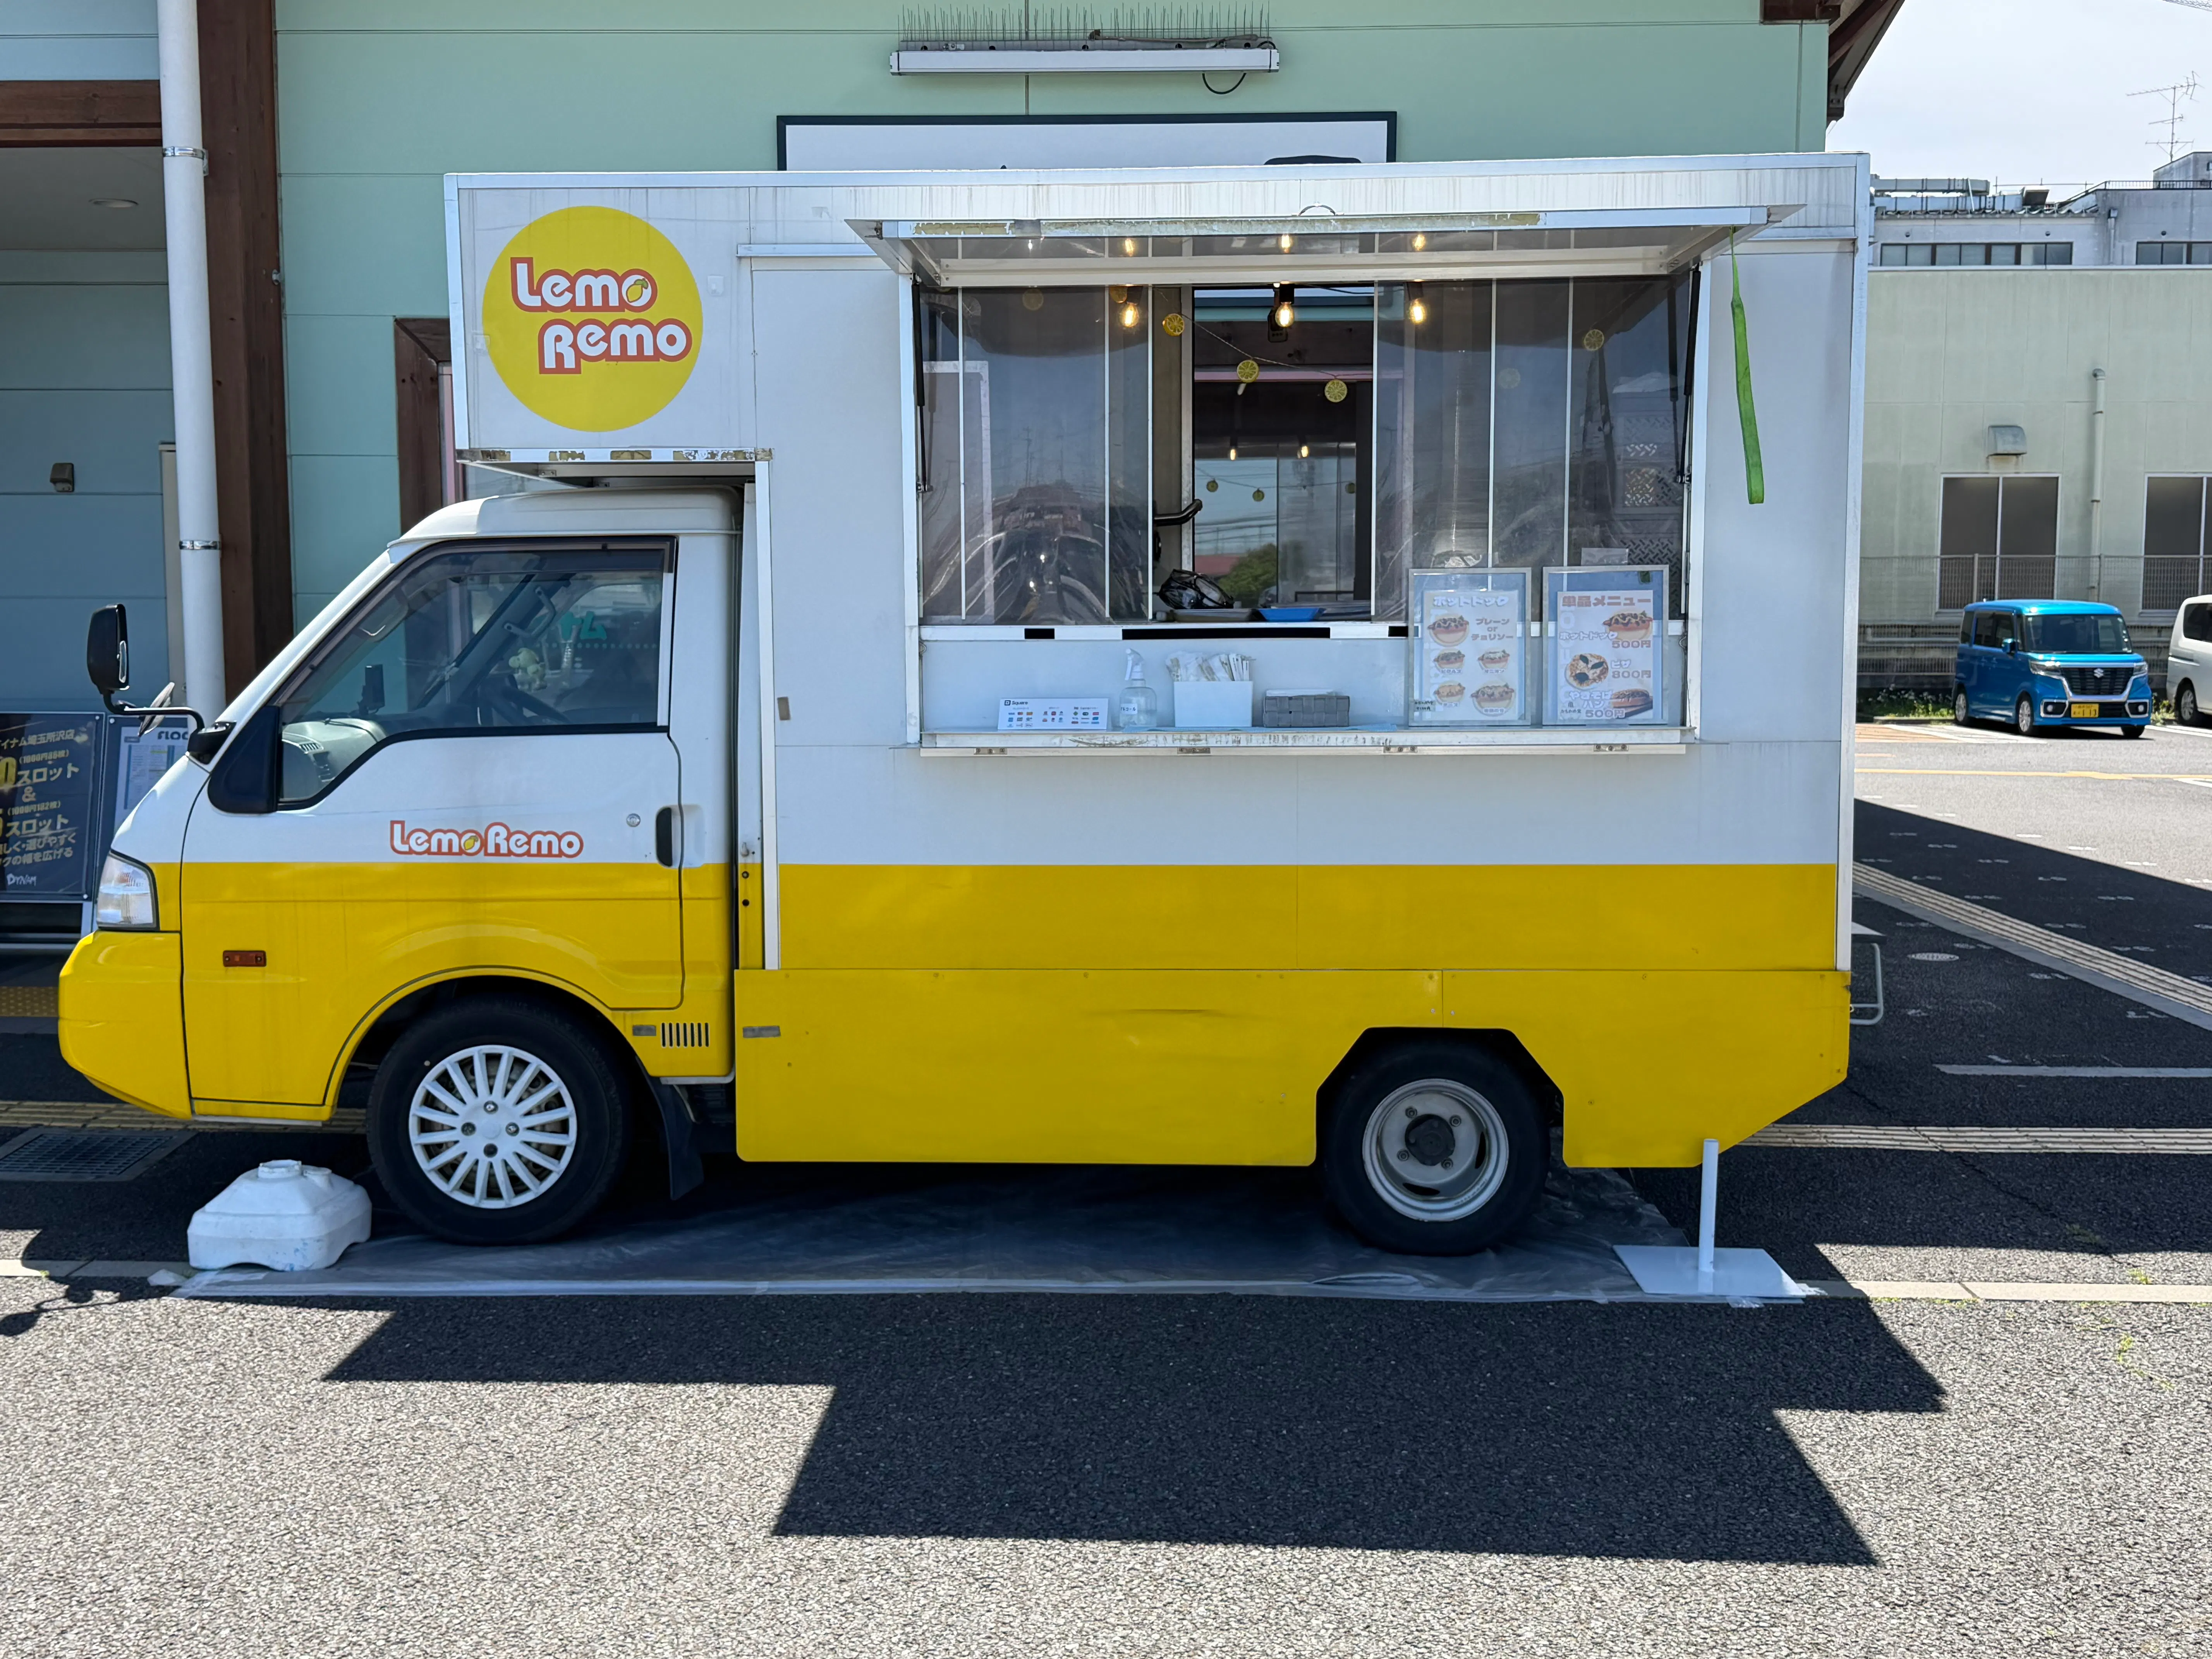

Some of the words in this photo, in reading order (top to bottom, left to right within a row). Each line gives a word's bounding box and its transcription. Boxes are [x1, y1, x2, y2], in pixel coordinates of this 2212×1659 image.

[510, 257, 658, 313] Lemo
[538, 318, 692, 374] Remo
[1562, 595, 1651, 607] 単品メニュー
[1612, 640, 1651, 648] 500円
[1612, 670, 1651, 678] 800円
[1585, 709, 1626, 718] 500円
[22, 786, 36, 803] &
[390, 820, 484, 856] Lemo
[484, 822, 584, 859] Remo
[6, 873, 37, 886] DYNAM
